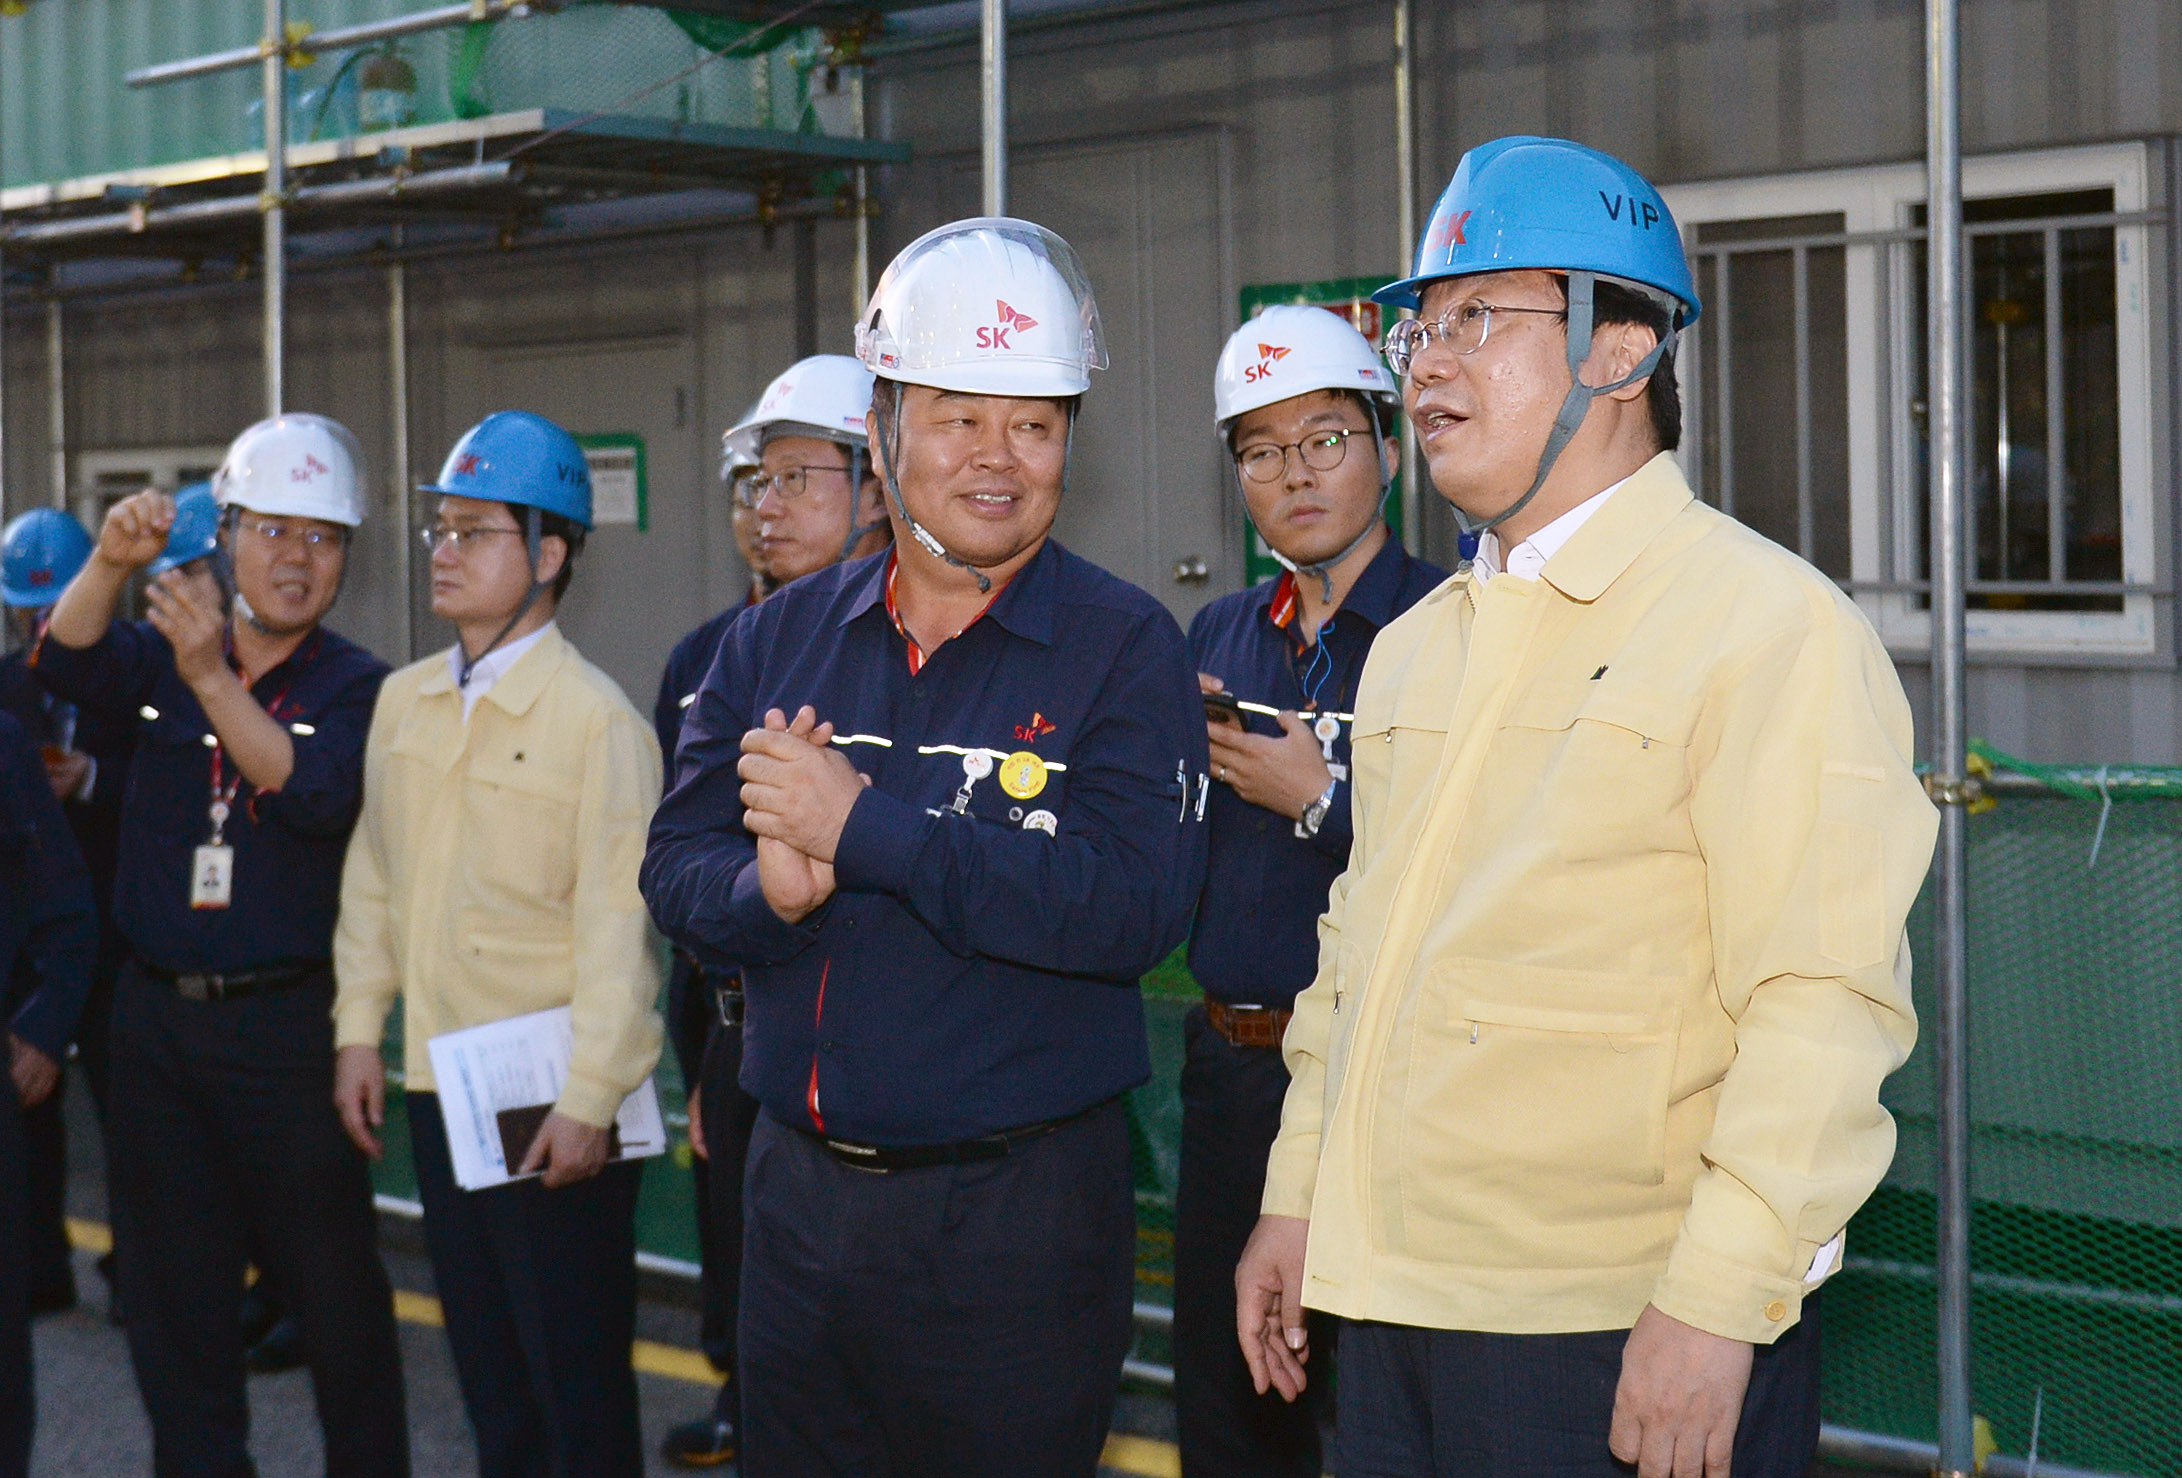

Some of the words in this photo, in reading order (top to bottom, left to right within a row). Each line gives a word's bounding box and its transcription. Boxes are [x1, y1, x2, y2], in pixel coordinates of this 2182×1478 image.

[1598, 190, 1660, 231] VIP
[1427, 210, 1473, 253] SK
[976, 326, 1011, 350] SK
[1244, 360, 1273, 384] SK
[455, 454, 482, 477] SK
[556, 461, 590, 489] VIP
[1013, 724, 1038, 743] SK
